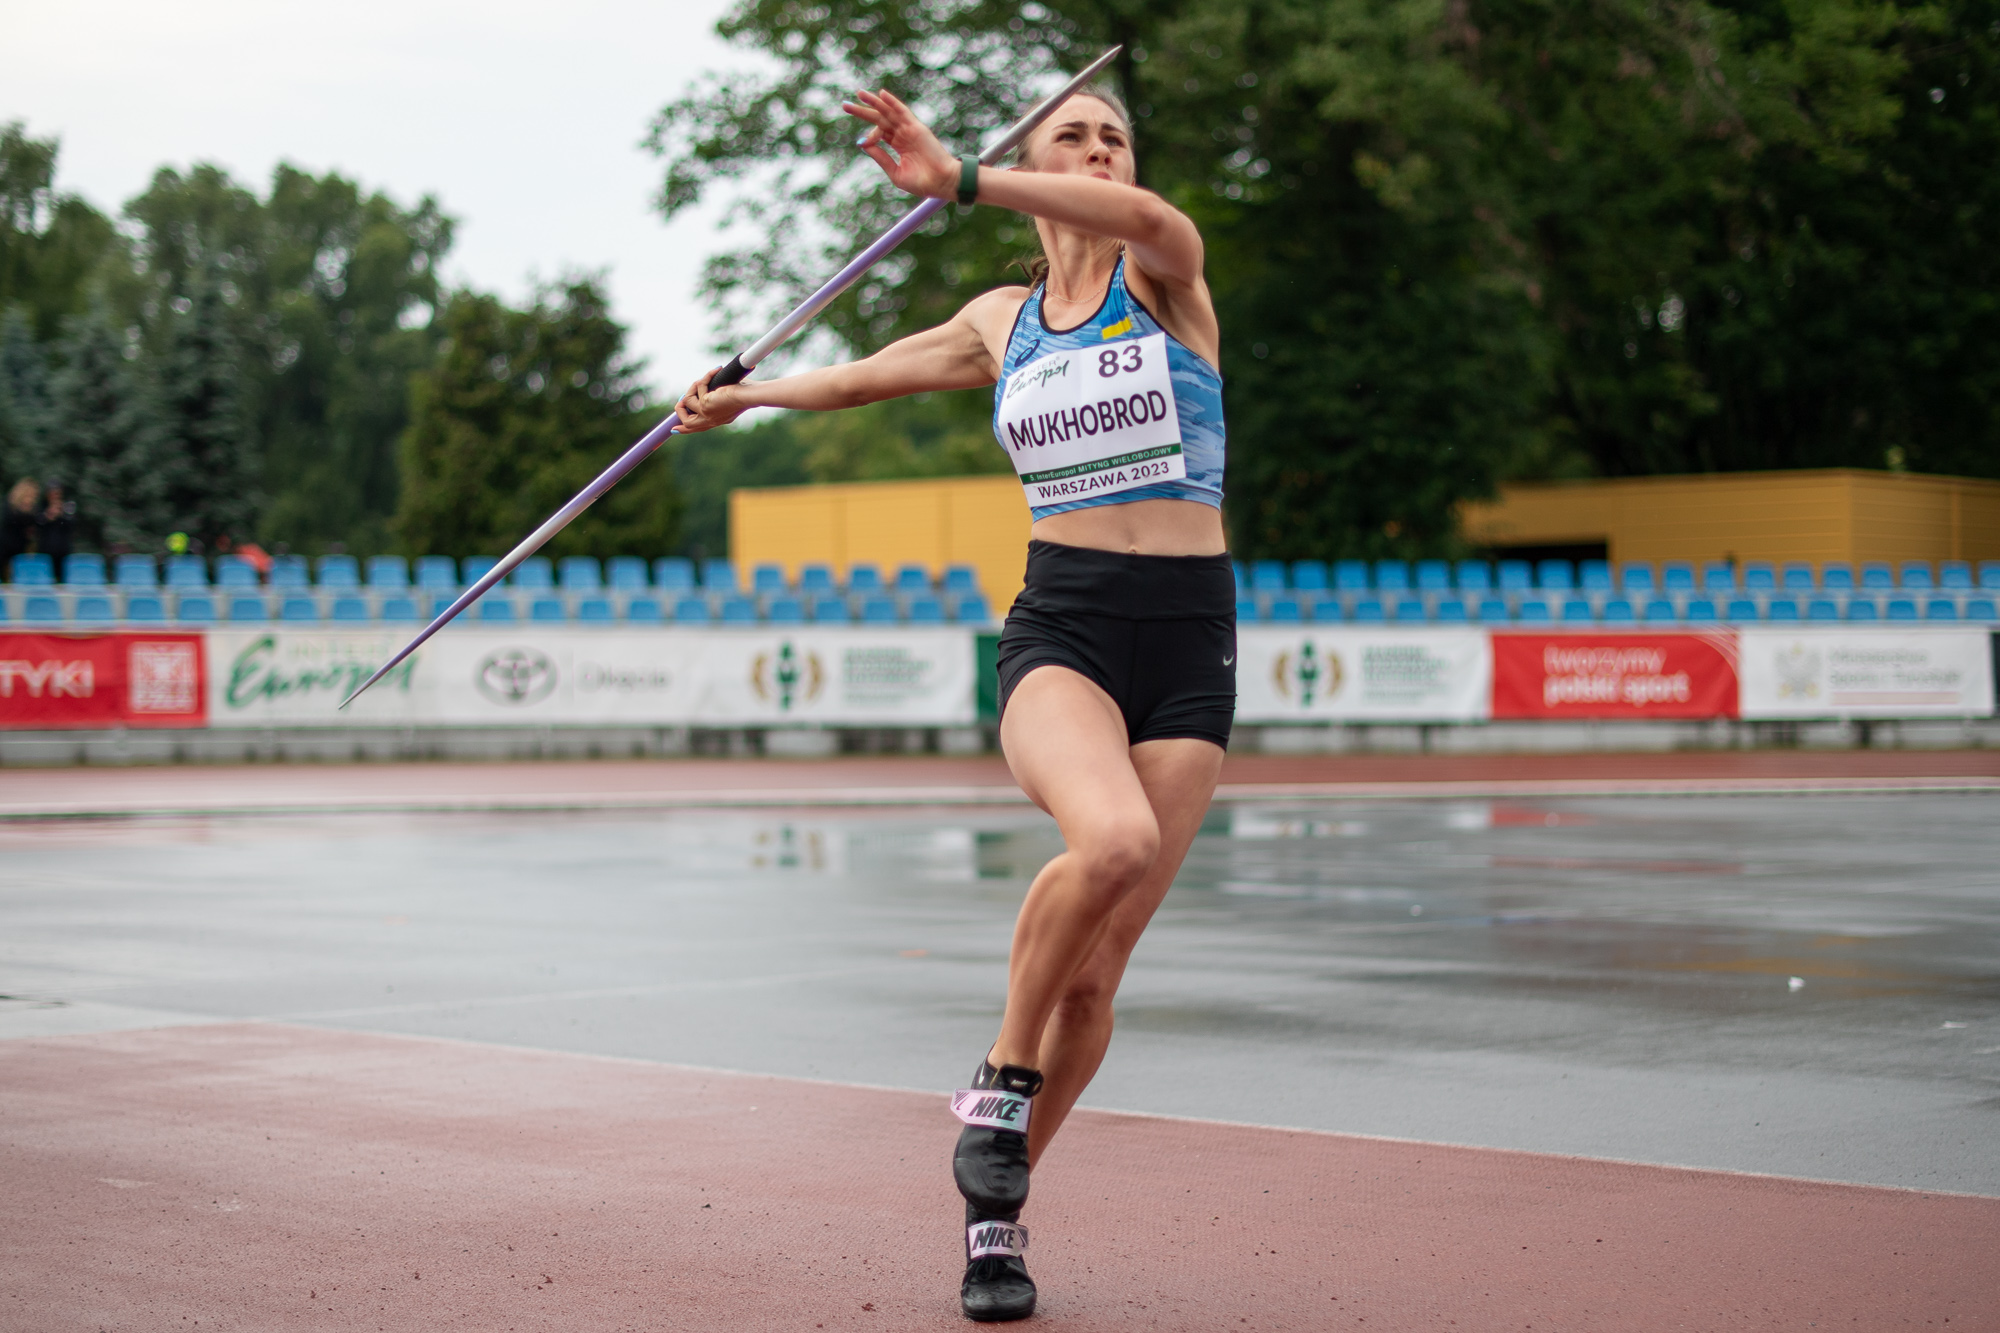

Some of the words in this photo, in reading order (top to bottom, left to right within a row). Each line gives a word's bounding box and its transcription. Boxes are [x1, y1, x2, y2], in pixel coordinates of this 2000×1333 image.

[1098, 344, 1143, 378] 83
[1006, 359, 1070, 399] Europol
[1007, 389, 1167, 451] MUKHOBROD
[1037, 467, 1076, 480] InterEuropol
[1077, 460, 1110, 473] MITYNG
[1111, 446, 1172, 466] WIELOBOJOWY
[1037, 470, 1128, 498] WARSZAWA
[1130, 461, 1169, 481] 2023
[968, 1096, 1025, 1122] NIKE
[971, 1226, 1015, 1250] NIKE
